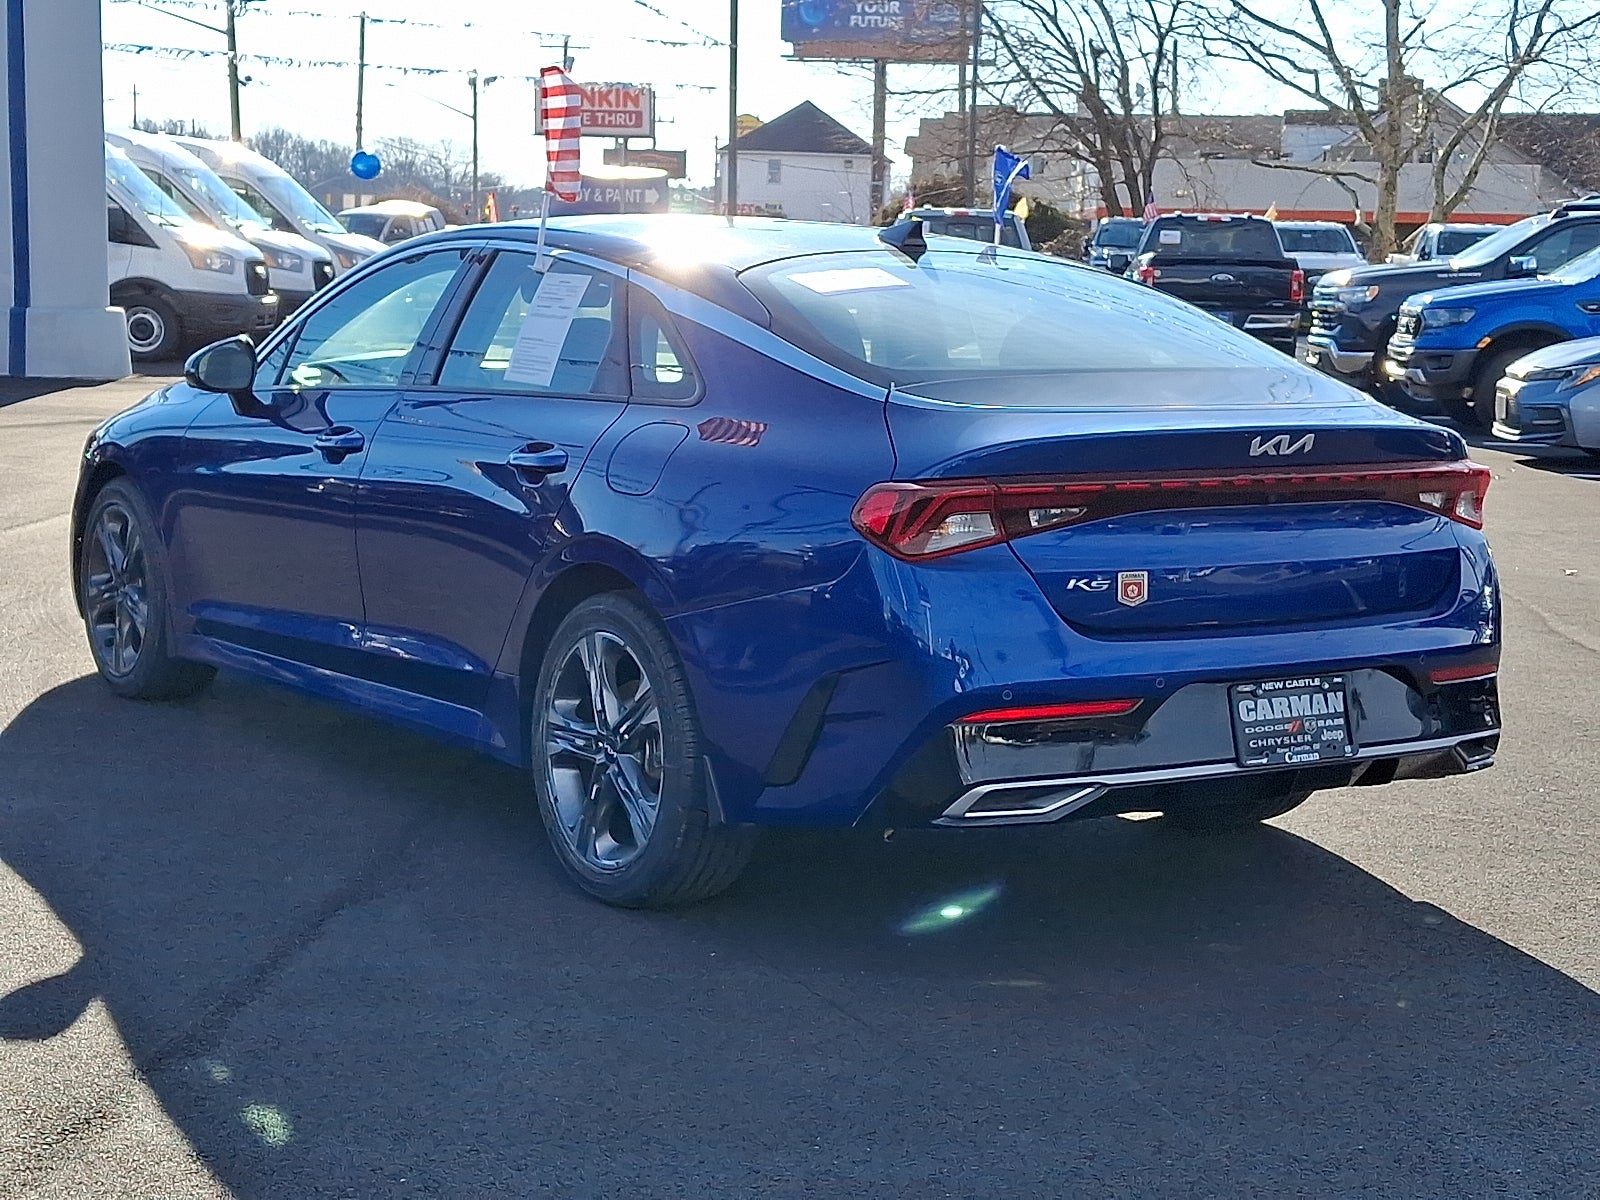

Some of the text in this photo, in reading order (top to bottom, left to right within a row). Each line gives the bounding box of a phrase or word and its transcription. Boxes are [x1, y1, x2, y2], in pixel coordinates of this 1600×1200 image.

[855, 0, 900, 13] YOUR
[850, 15, 904, 30] FUTURE
[595, 112, 636, 126] THRU
[594, 187, 603, 202] &
[606, 187, 642, 203] PANT
[1261, 682, 1284, 690] NEW
[1285, 677, 1321, 688] CASTLE
[1238, 691, 1344, 722] CARMAN
[1244, 723, 1293, 734] DODGE
[1249, 728, 1344, 748] CHRYSLER Jeep
[1284, 752, 1320, 763] Carman
